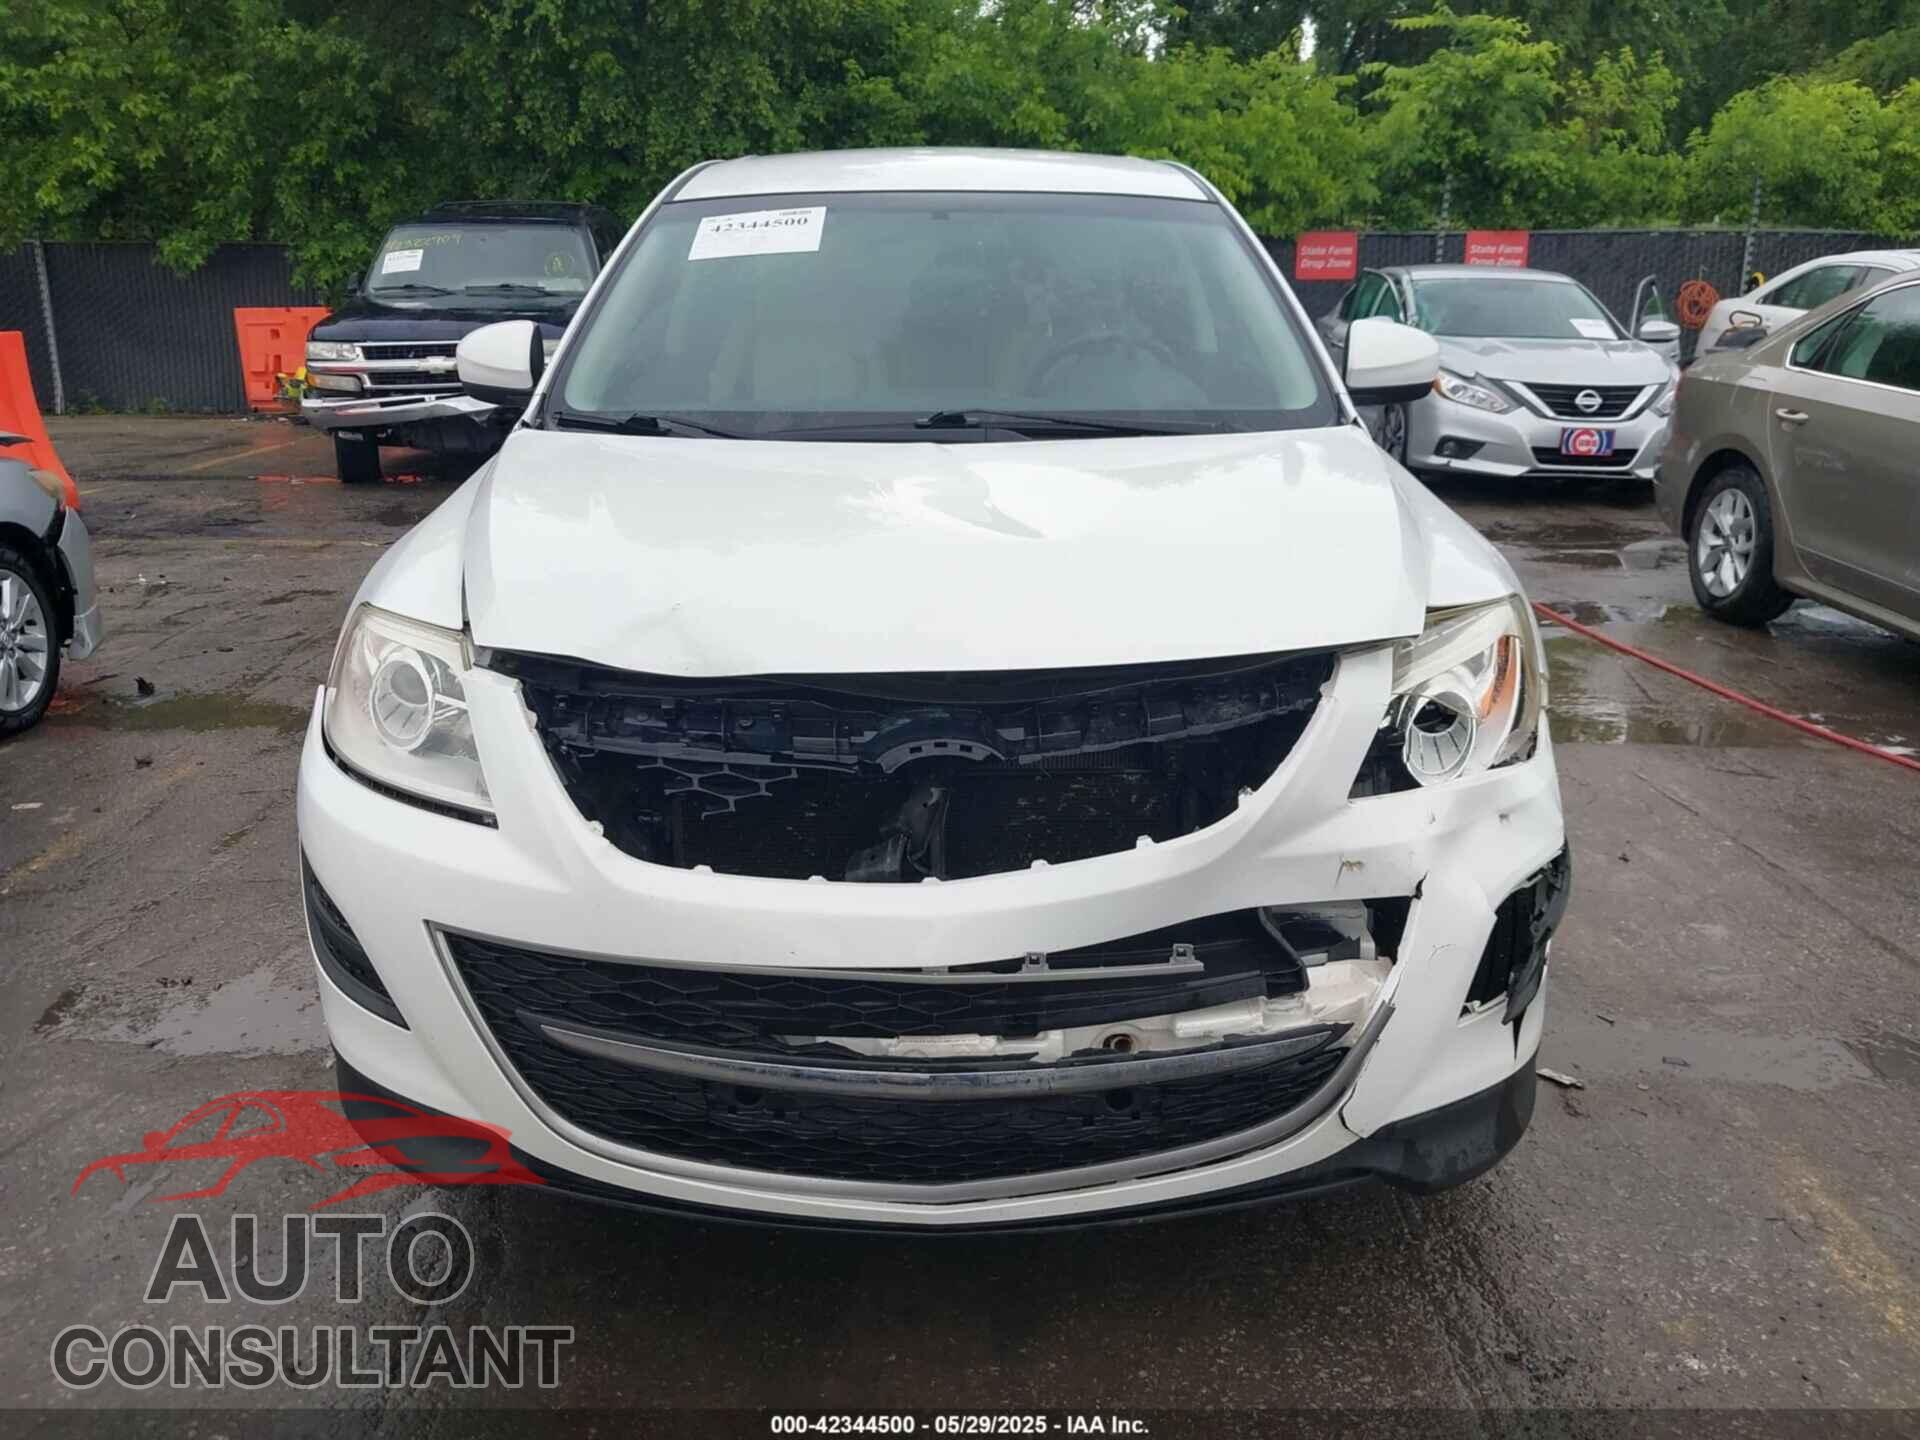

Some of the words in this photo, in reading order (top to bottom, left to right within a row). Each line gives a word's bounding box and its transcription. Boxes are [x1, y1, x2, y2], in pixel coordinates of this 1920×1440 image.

[710, 217, 808, 232] 42344500
[1301, 245, 1327, 255] State
[1328, 245, 1352, 255] Farm
[1470, 244, 1497, 254] State
[1498, 244, 1523, 254] Farm
[1301, 258, 1324, 270] Drop
[1326, 258, 1351, 268] Zone
